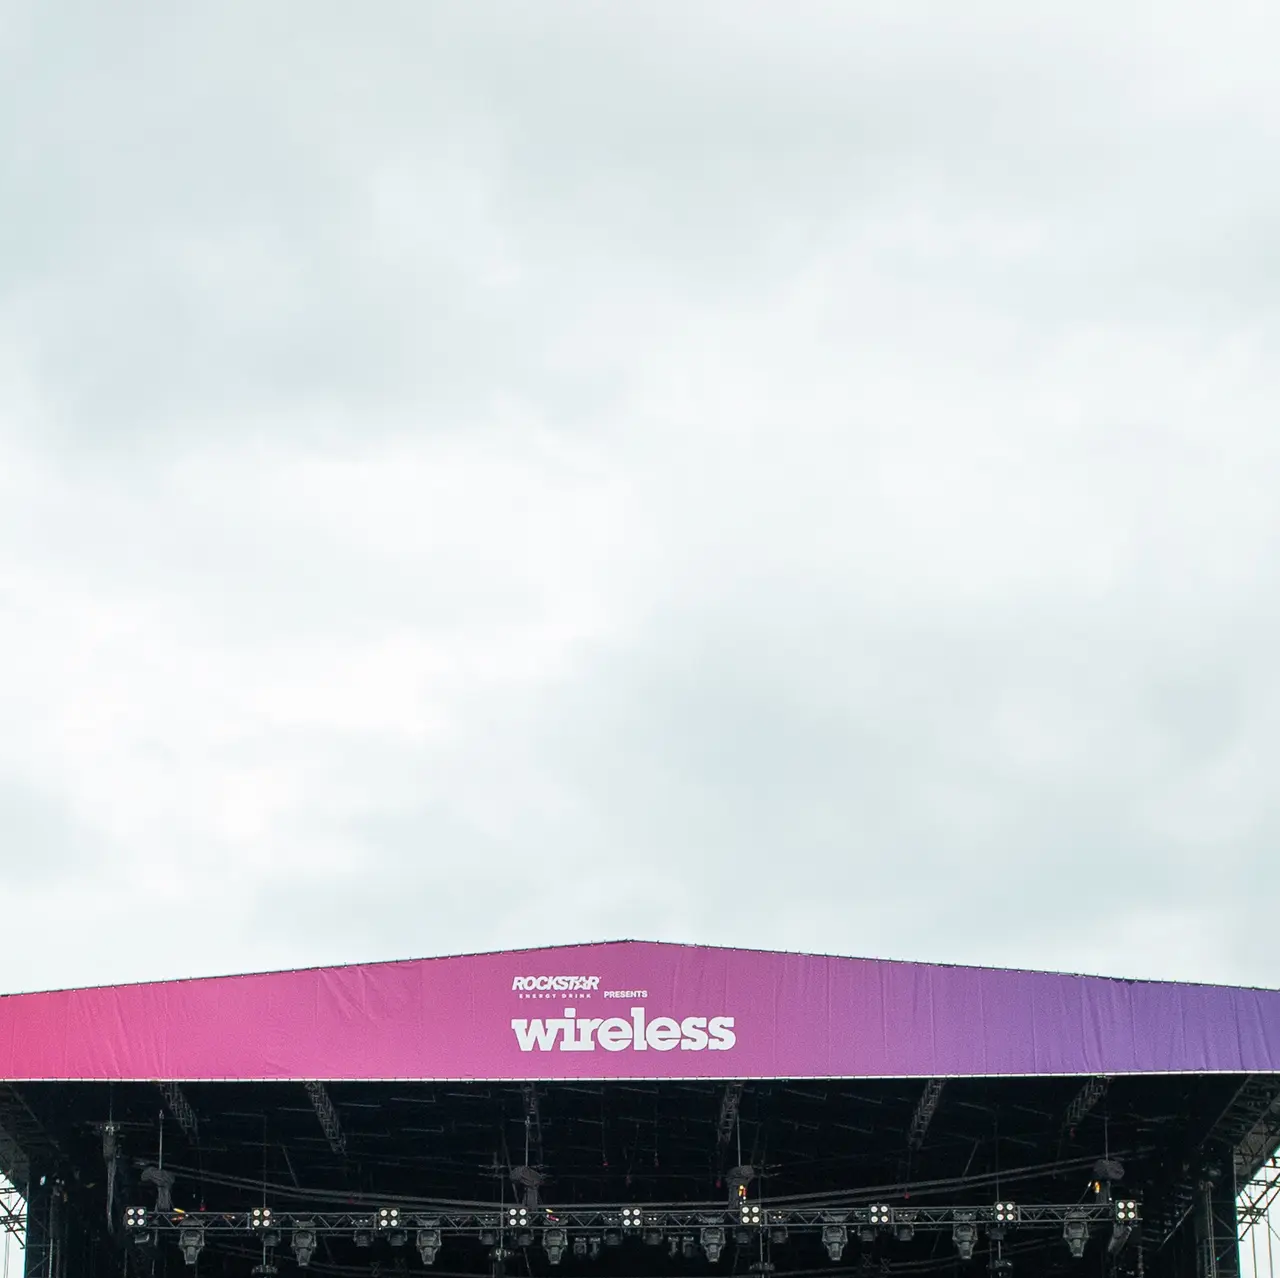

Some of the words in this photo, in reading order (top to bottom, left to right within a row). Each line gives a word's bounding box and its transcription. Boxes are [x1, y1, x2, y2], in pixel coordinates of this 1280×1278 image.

[512, 976, 600, 990] ROCKSTAR
[604, 990, 648, 998] PRESENTS
[511, 1007, 737, 1051] wireless
